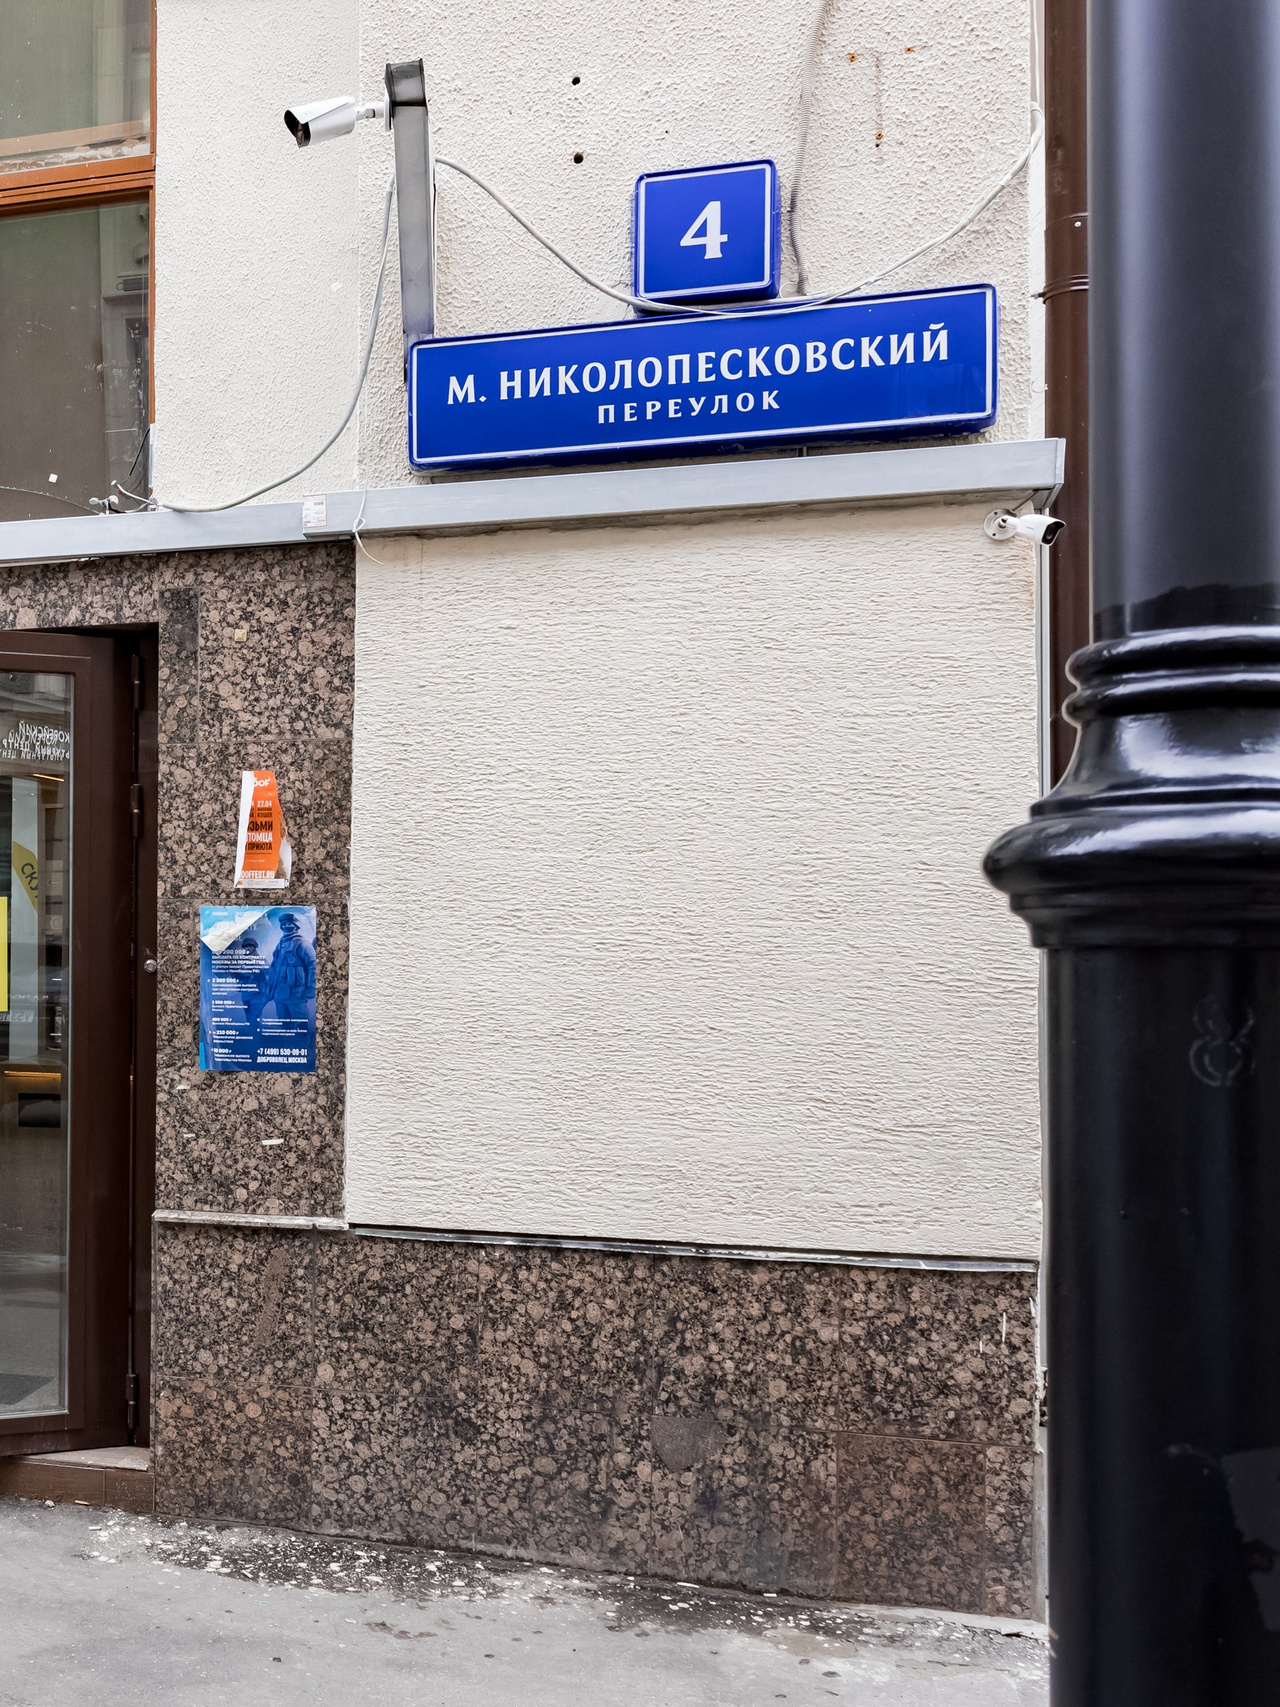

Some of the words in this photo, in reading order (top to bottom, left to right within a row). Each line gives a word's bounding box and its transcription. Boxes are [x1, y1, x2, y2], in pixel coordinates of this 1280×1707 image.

[679, 200, 729, 260] 4
[447, 374, 487, 405] М.
[499, 322, 950, 402] НИКОЛОПЕСКОВСКИЙ
[597, 389, 782, 425] ПЕРЕУЛОК
[246, 832, 273, 842] ТОМЦА
[248, 821, 273, 831] ЗЬМИ
[21, 862, 38, 898] СКУ
